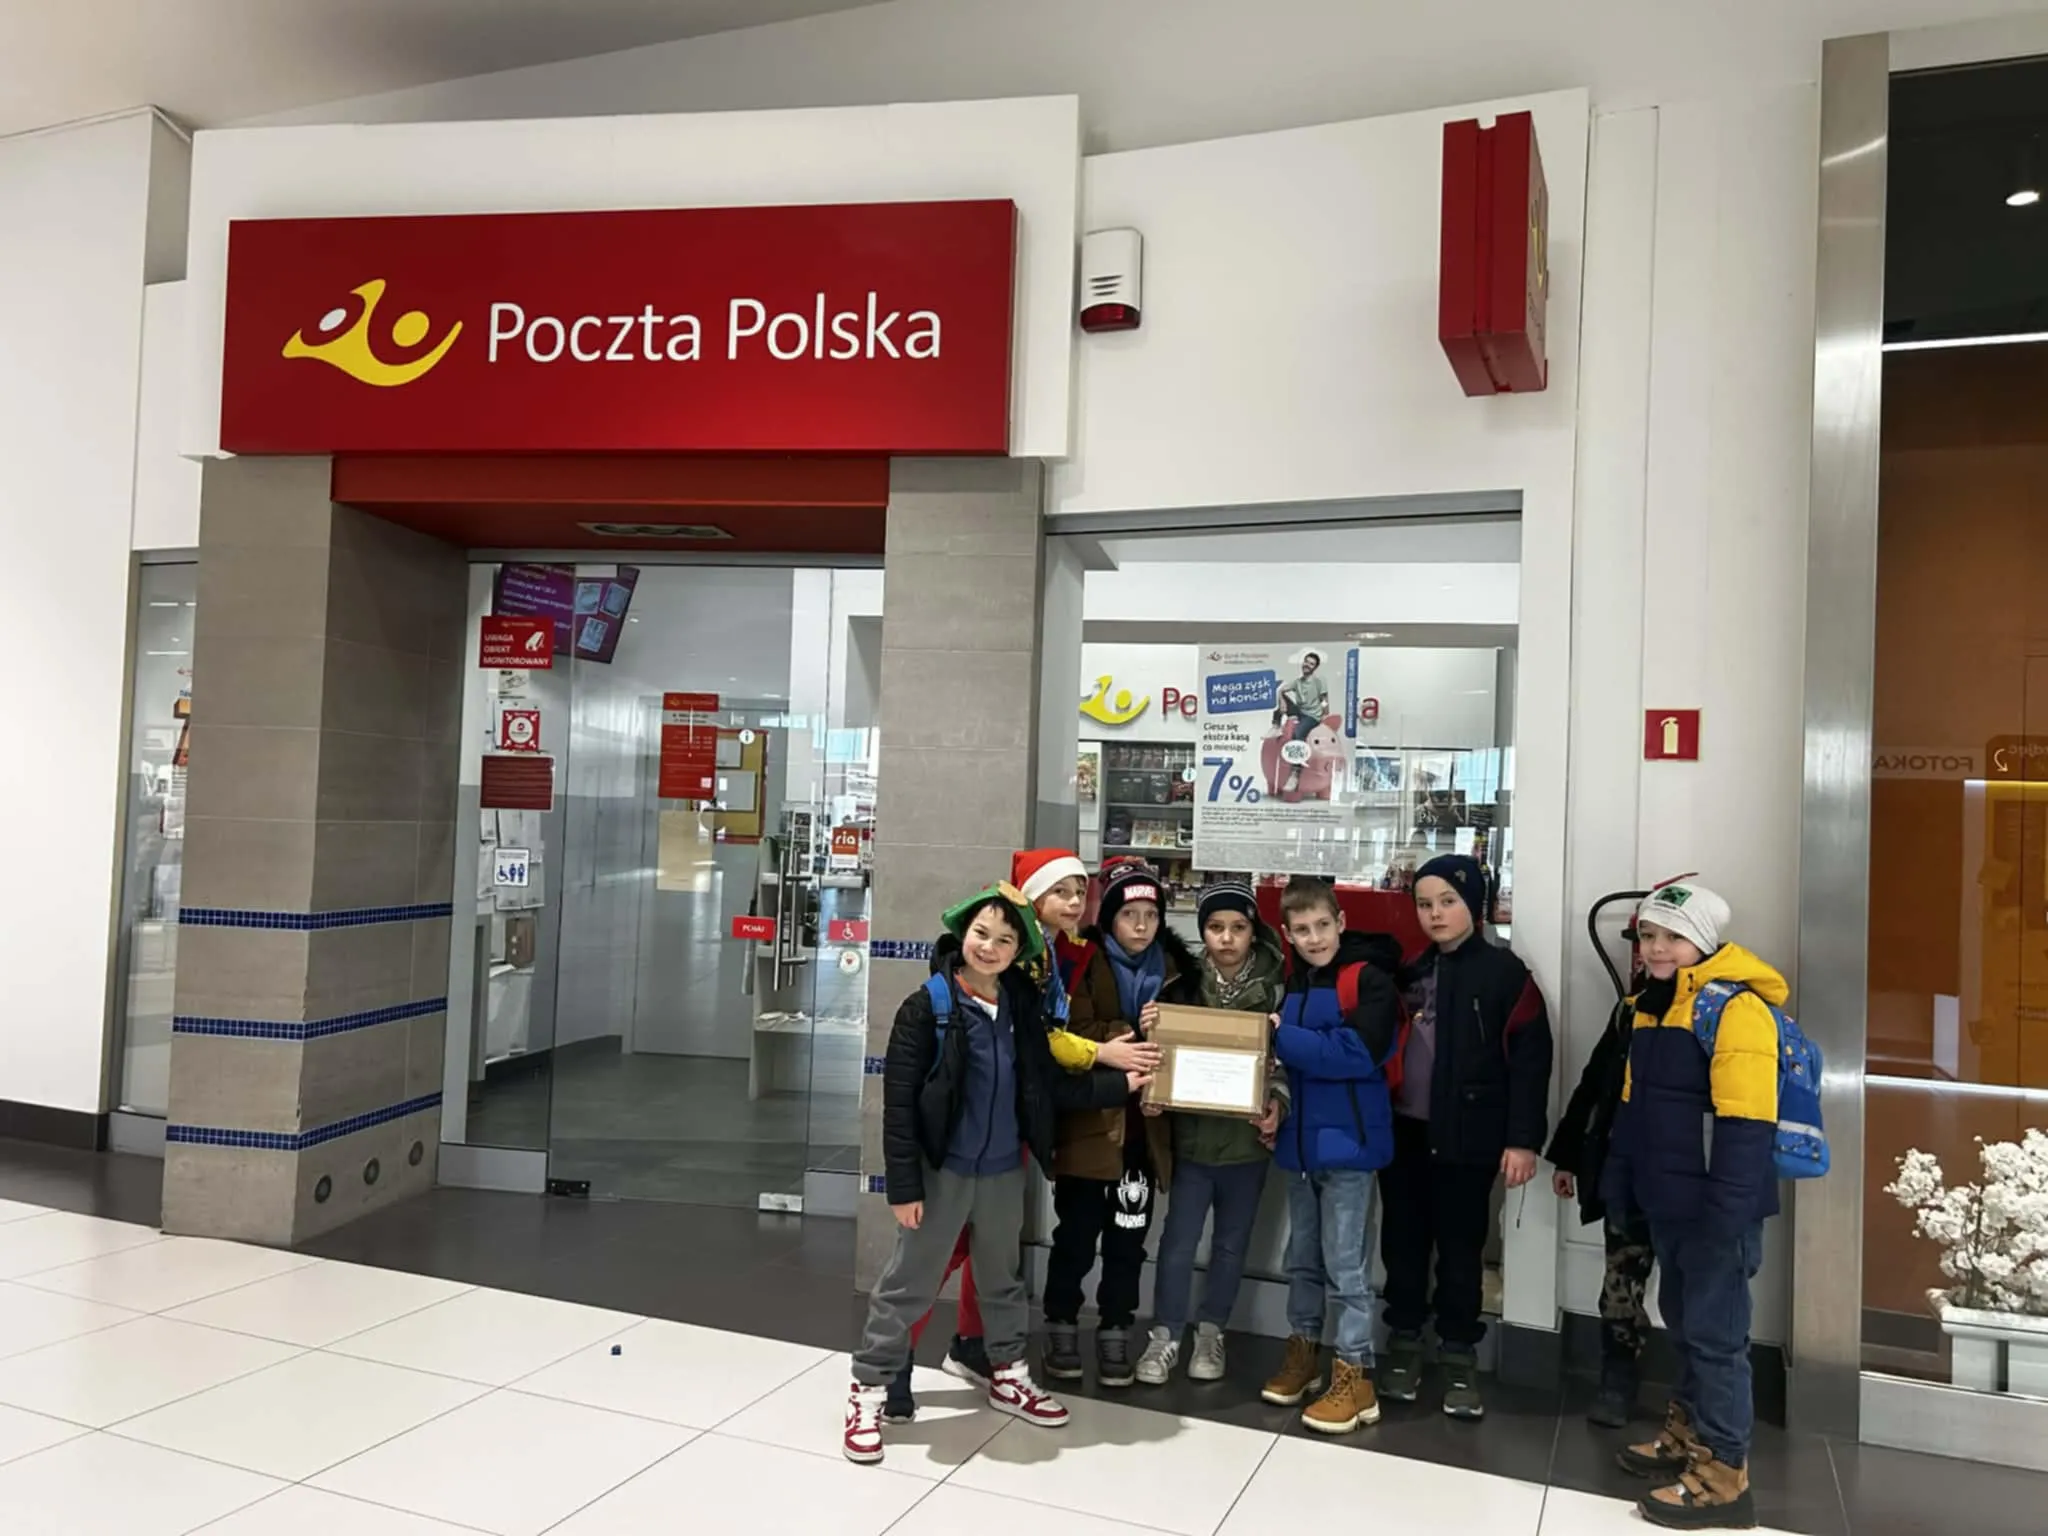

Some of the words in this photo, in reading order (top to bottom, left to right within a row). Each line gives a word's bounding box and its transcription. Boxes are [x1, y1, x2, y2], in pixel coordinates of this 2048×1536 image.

[488, 302, 701, 363] Poczta
[727, 291, 941, 361] Polska
[484, 633, 515, 642] UWAGA
[483, 645, 511, 653] OBIEKT
[483, 655, 550, 666] MONITOROWANY
[1212, 682, 1243, 697] Mega
[1244, 676, 1271, 692] zysk
[1211, 696, 1227, 705] na
[1228, 689, 1273, 705] koncie!
[1203, 722, 1223, 732] Ciesz
[1225, 722, 1239, 734] się
[1203, 732, 1228, 741] ekstra
[1230, 732, 1250, 743] kasą
[1202, 757, 1261, 803] 7%
[835, 830, 856, 845] ria
[1123, 885, 1157, 900] MARVEL
[741, 924, 766, 933] PCHAJ
[1114, 1211, 1146, 1229] MARVEL
